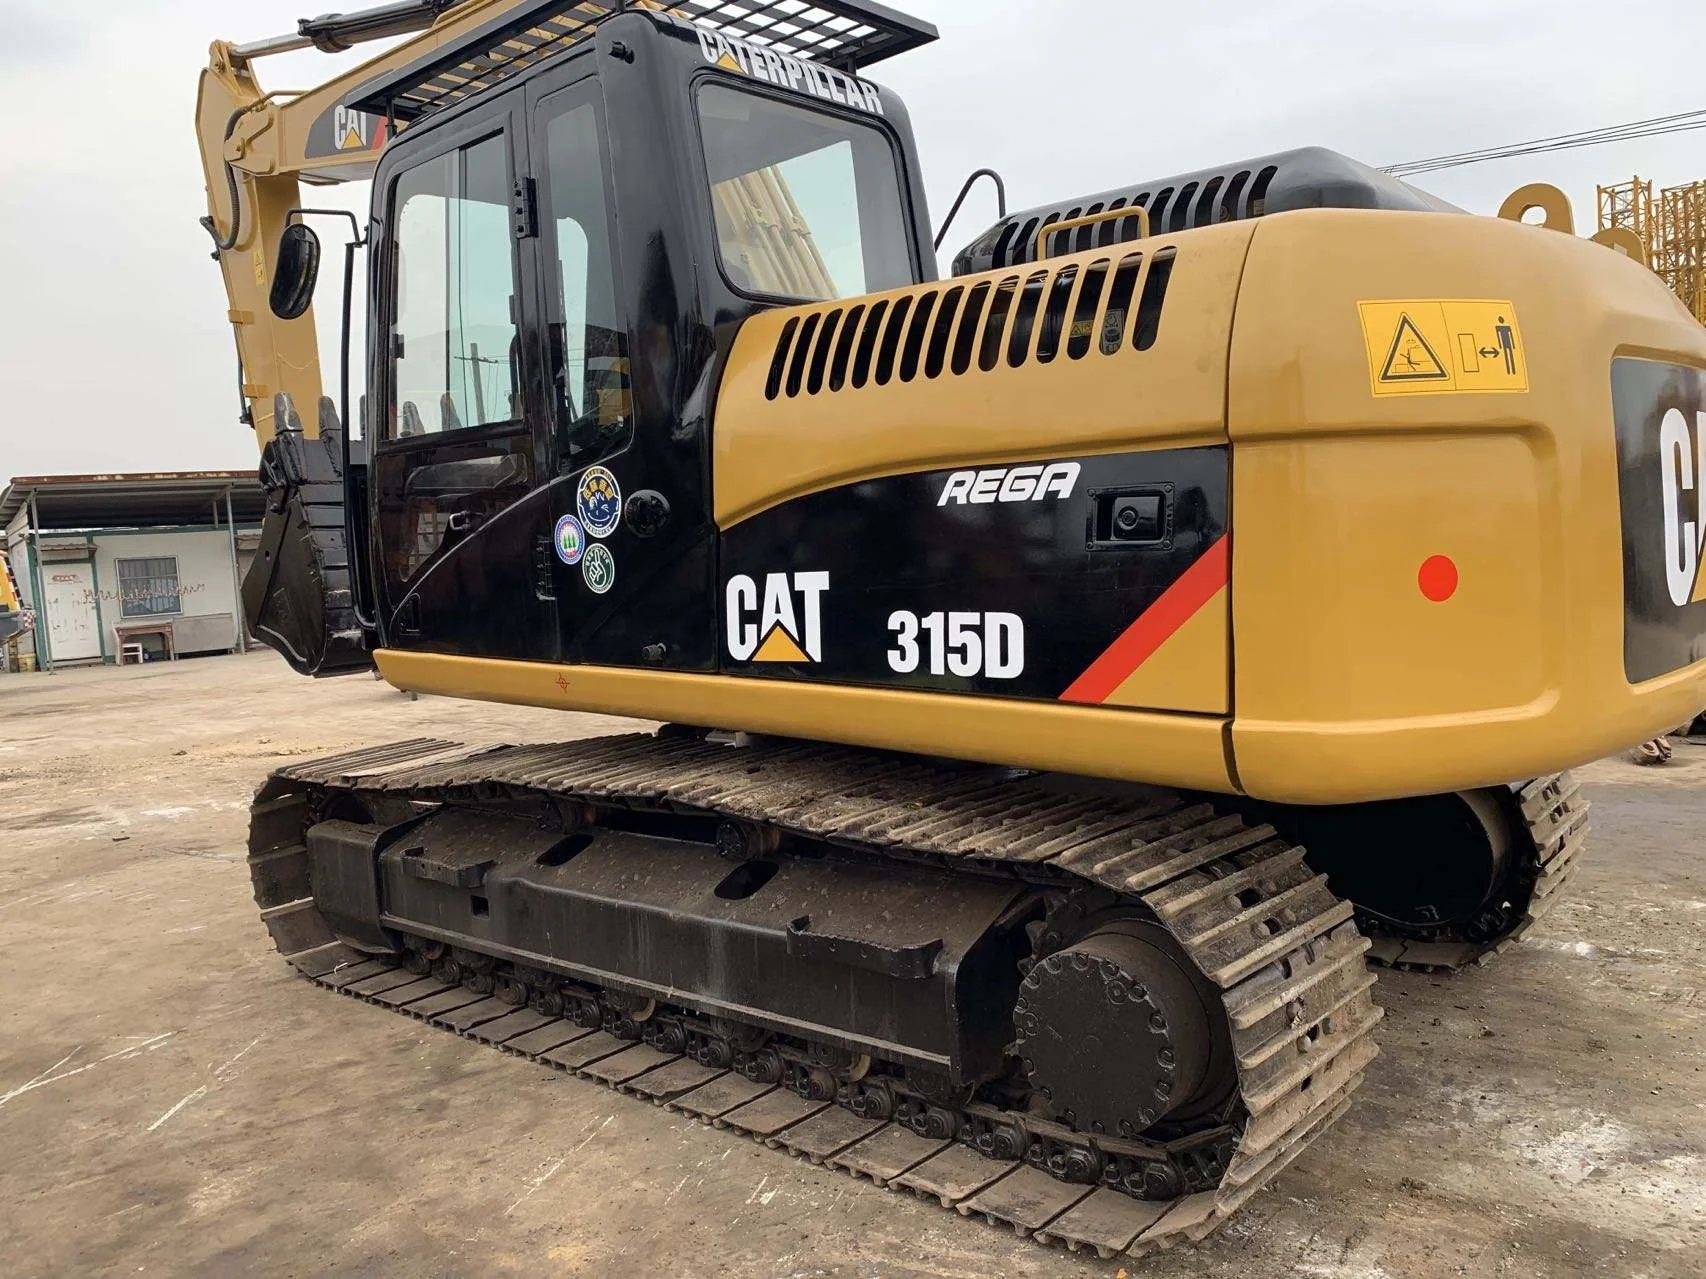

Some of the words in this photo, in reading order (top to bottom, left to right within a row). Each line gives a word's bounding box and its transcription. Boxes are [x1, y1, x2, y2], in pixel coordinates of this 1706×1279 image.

[696, 27, 884, 115] CATERPILLAR
[335, 105, 367, 149] CAT
[937, 462, 1080, 507] REGA
[726, 571, 830, 663] CAT
[886, 610, 1024, 679] 315D
